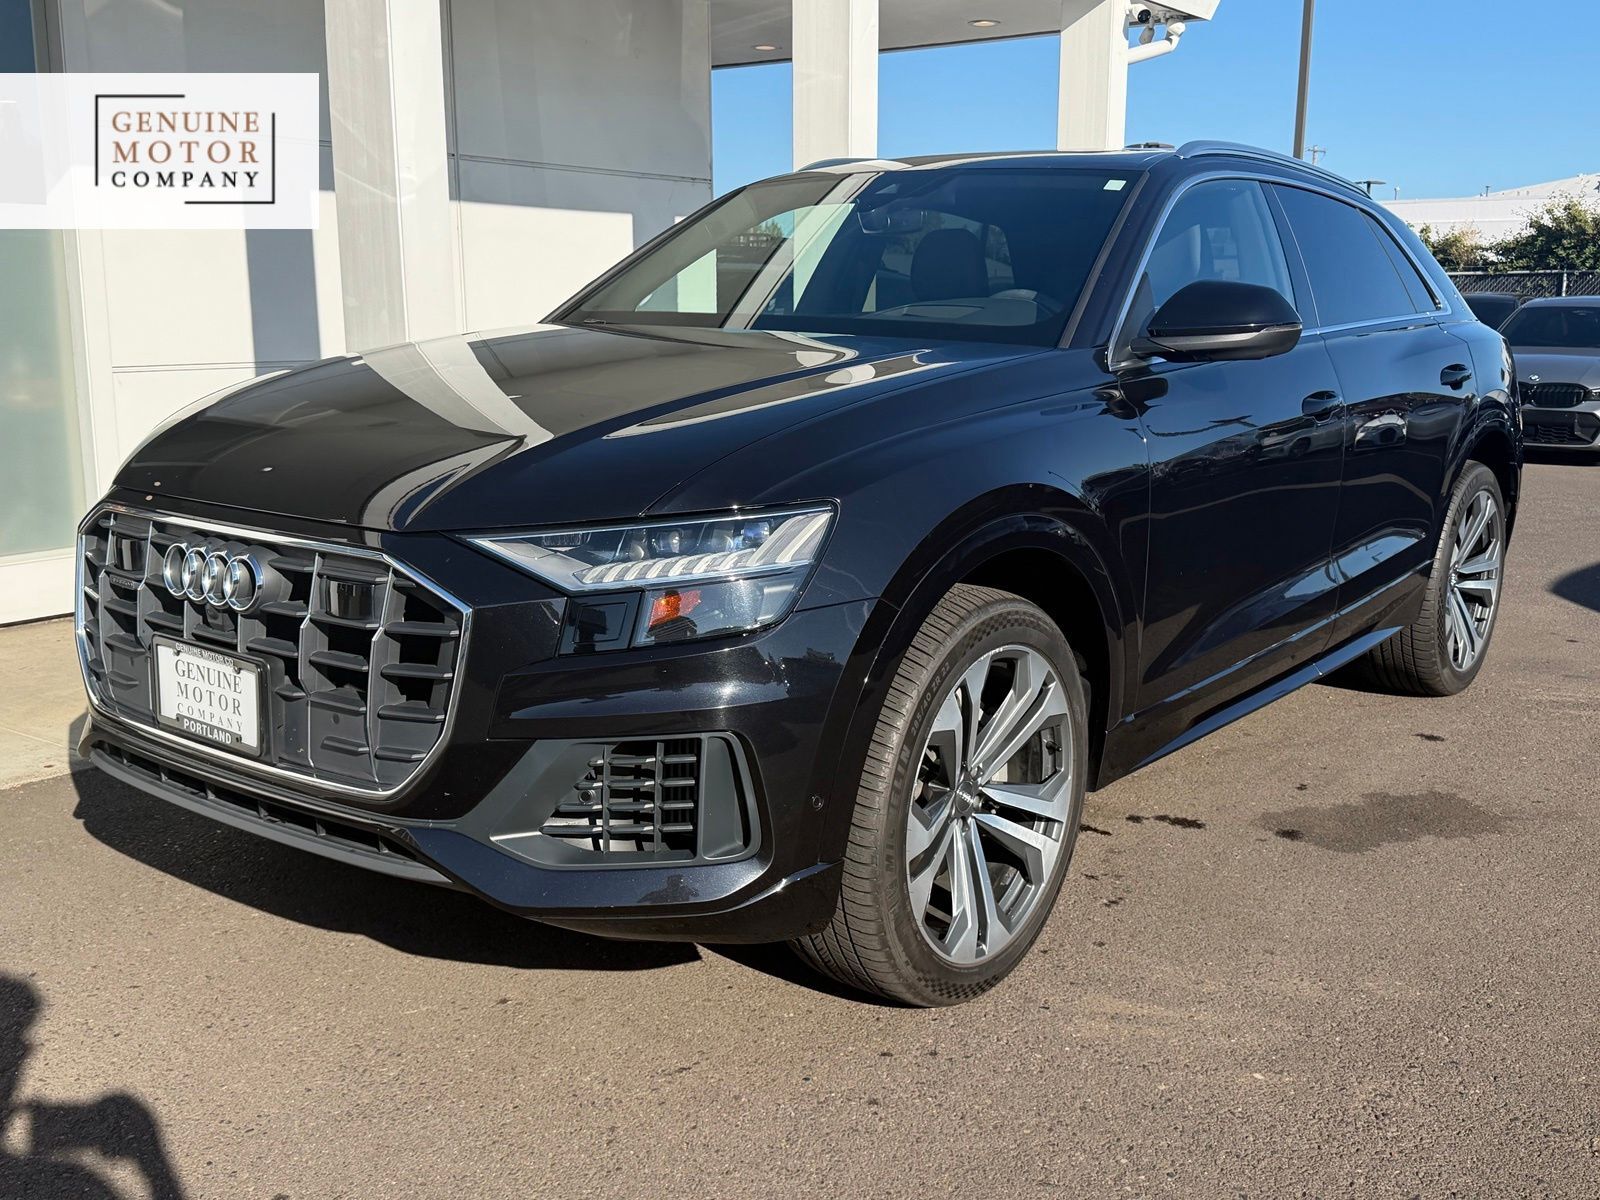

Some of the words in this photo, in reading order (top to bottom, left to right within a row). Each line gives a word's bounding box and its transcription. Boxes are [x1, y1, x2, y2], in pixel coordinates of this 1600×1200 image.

[175, 642, 203, 659] GENUINE
[174, 659, 242, 694] GENUINE
[176, 681, 242, 717] MOTOR
[177, 702, 243, 732] COMPANY
[183, 718, 232, 745] PORTLAND
[884, 743, 911, 872] MICELIN
